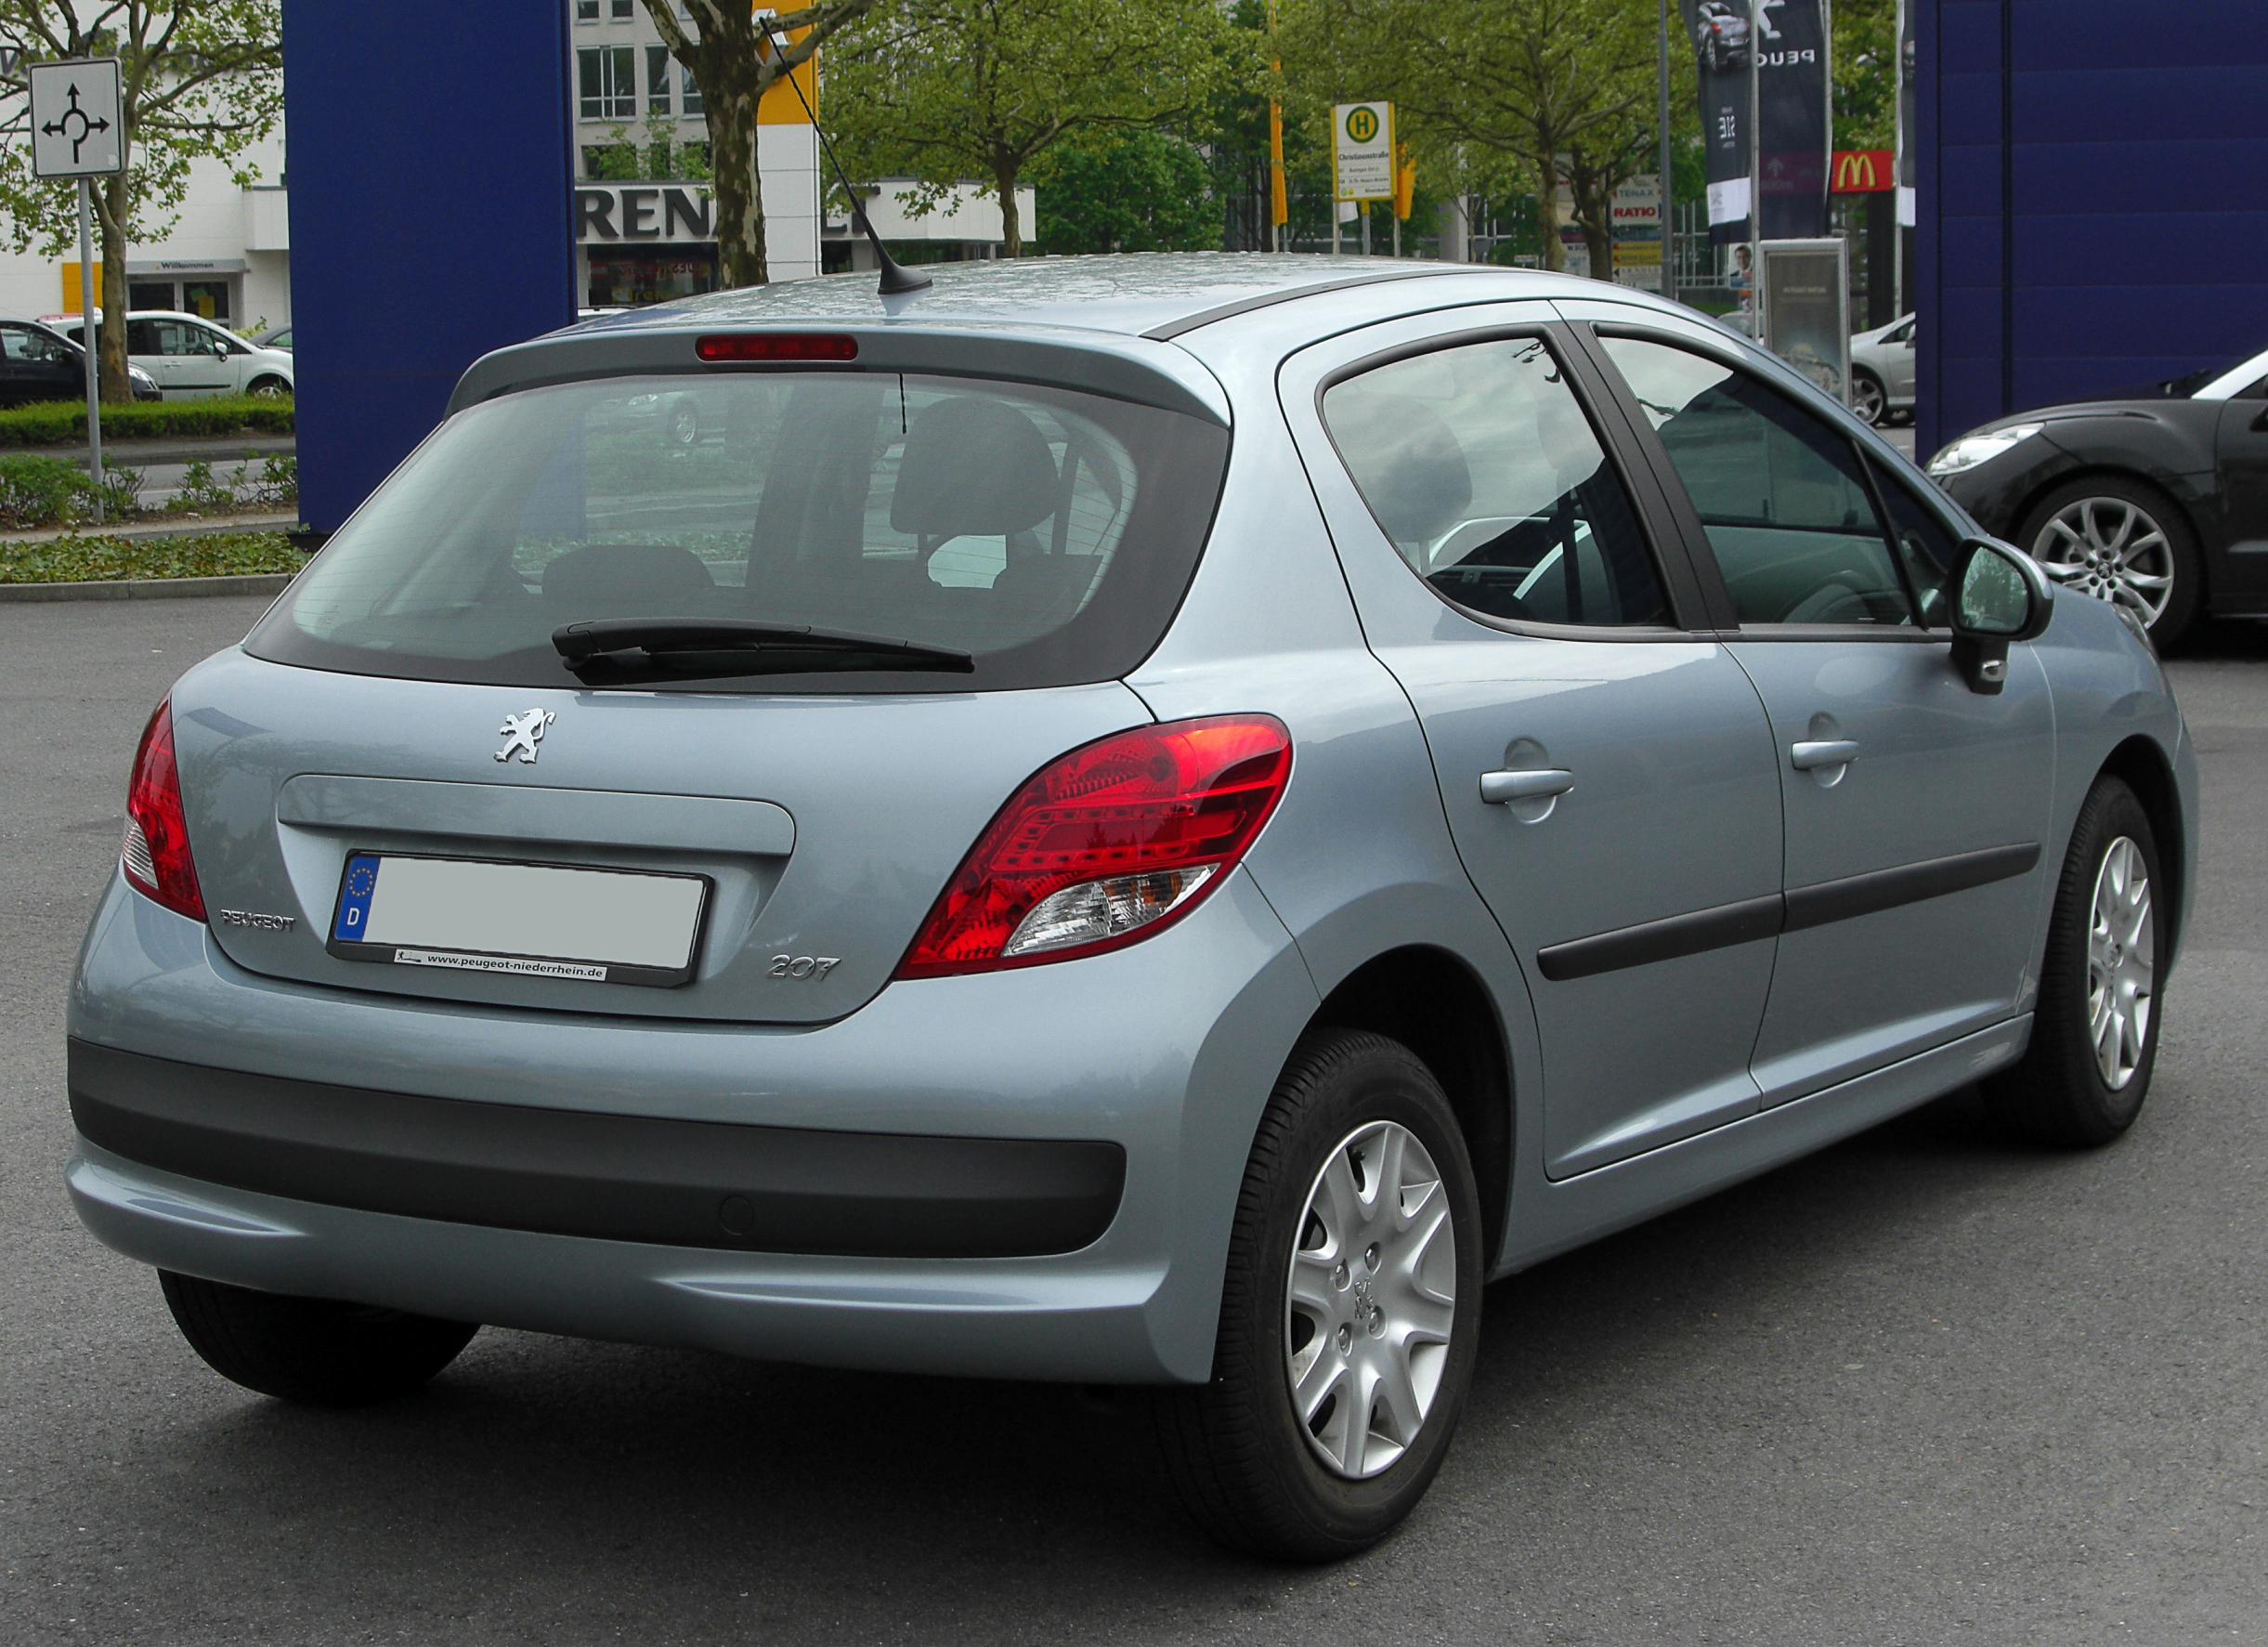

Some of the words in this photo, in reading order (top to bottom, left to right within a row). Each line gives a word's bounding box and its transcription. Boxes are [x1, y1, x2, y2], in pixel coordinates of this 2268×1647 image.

[1356, 113, 1369, 135] H
[1338, 151, 1389, 161] Christinenstraße
[1619, 189, 1655, 198] TENAX
[1613, 206, 1657, 217] RATIO
[161, 261, 215, 269] Willkommen
[220, 908, 296, 933] PEUGEOT
[346, 907, 360, 926] D
[426, 954, 604, 978] www.peugeot-niederrhein.de
[766, 953, 841, 981] 207
